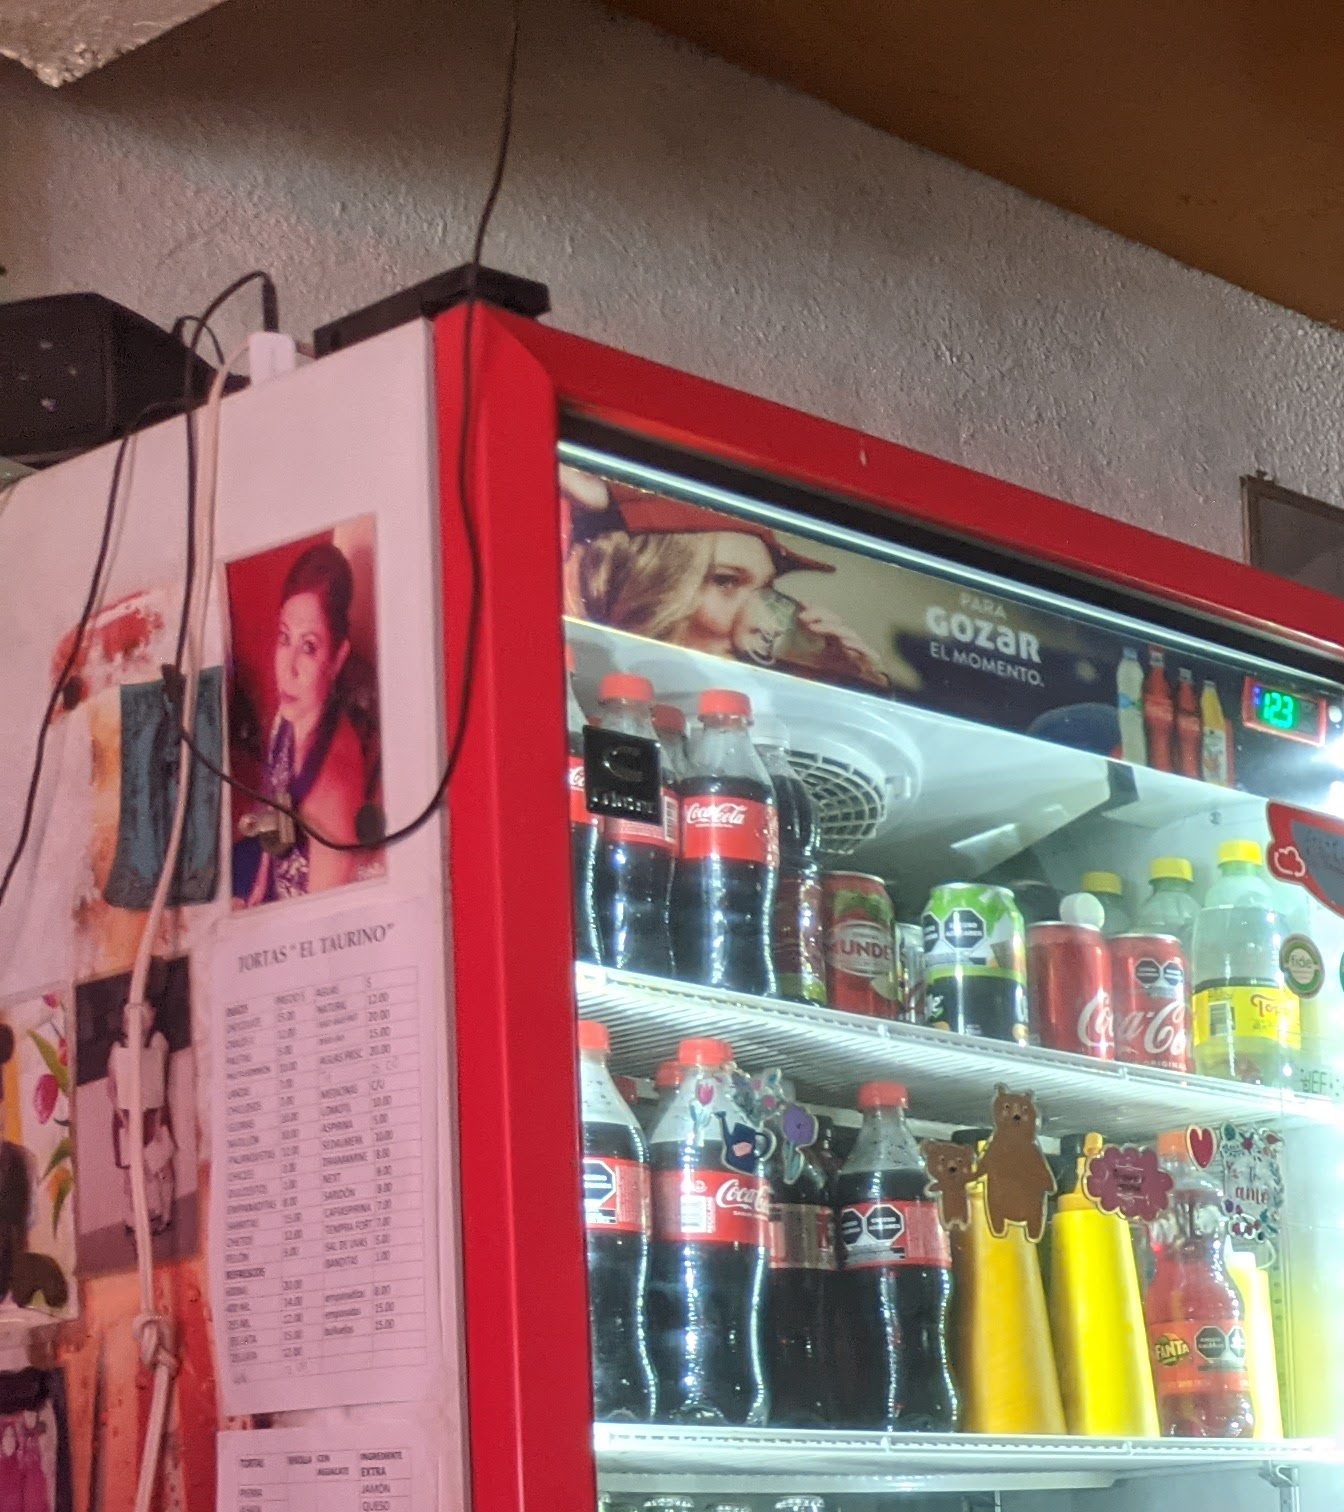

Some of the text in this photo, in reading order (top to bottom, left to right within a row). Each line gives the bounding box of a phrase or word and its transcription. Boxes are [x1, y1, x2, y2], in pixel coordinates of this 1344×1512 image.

[959, 592, 1008, 620] PARA
[930, 641, 1045, 688] EL MOMENTO.
[686, 802, 748, 825] Coca-Cola
[238, 946, 288, 972] TORTAS
[1154, 1340, 1190, 1362] FANTA
[360, 1466, 386, 1477] EXTRA
[362, 1500, 391, 1512] QUESO
